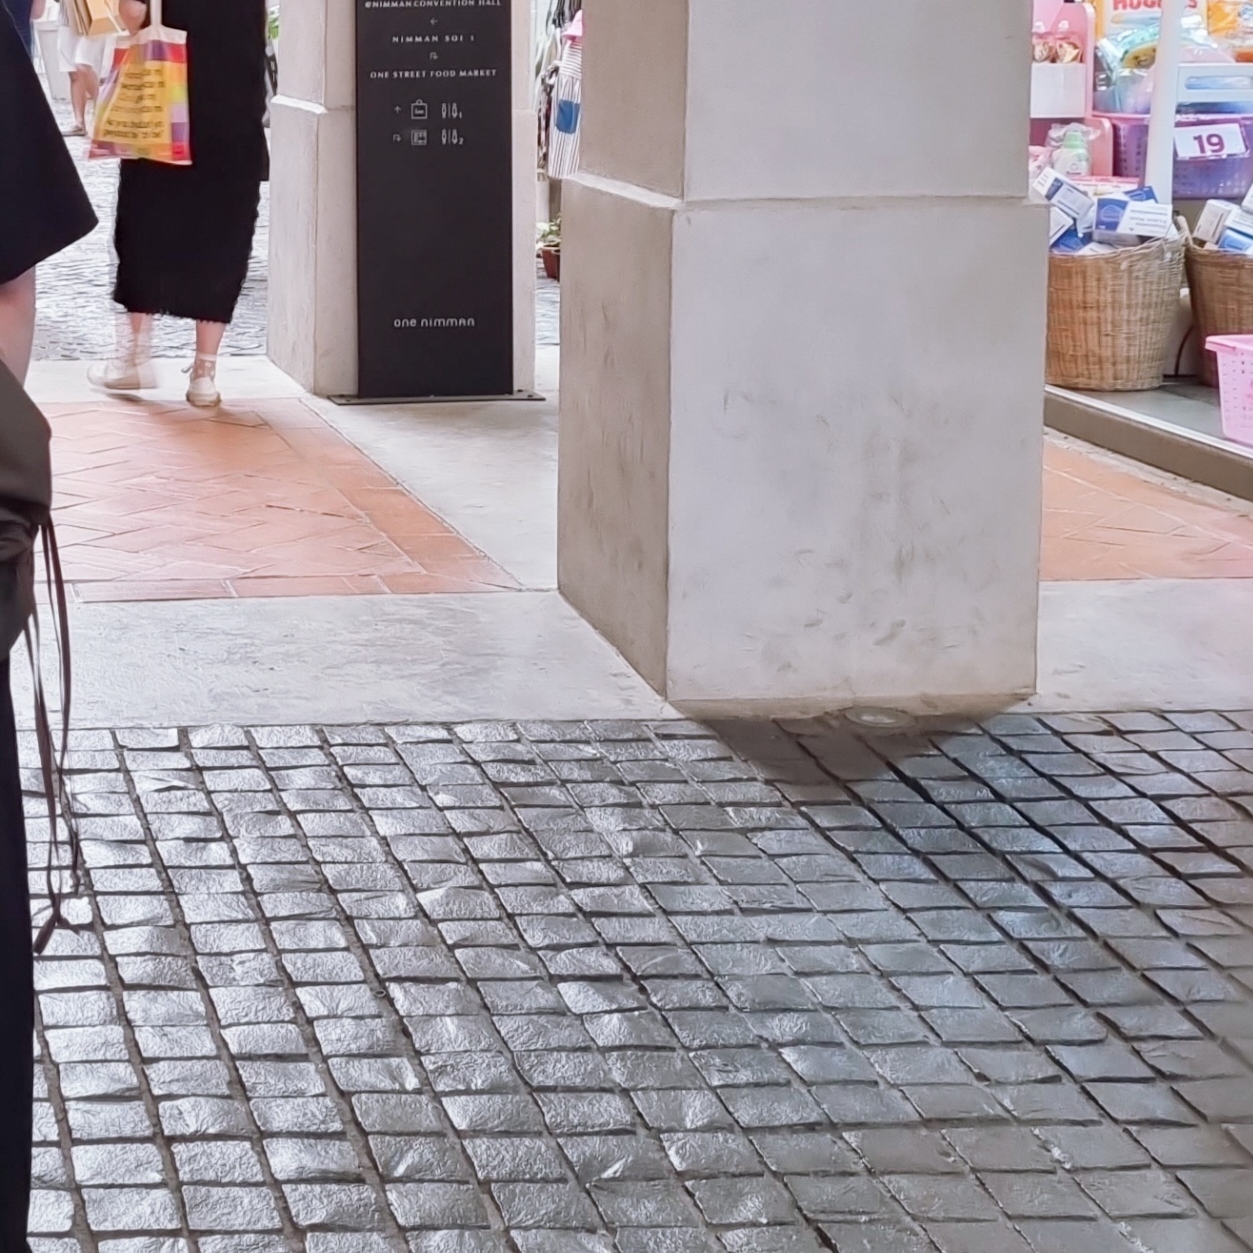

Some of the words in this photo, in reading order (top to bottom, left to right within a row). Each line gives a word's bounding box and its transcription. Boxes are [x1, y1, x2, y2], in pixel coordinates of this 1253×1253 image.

[392, 35, 439, 43] NIMMAN
[444, 34, 464, 42] SOI
[370, 71, 389, 79] ONE
[393, 70, 426, 79] STREET
[430, 69, 456, 78] FOOD
[459, 69, 497, 77] MARKET
[1193, 133, 1225, 155] 19
[393, 318, 417, 327] one
[420, 317, 475, 327] nimman
